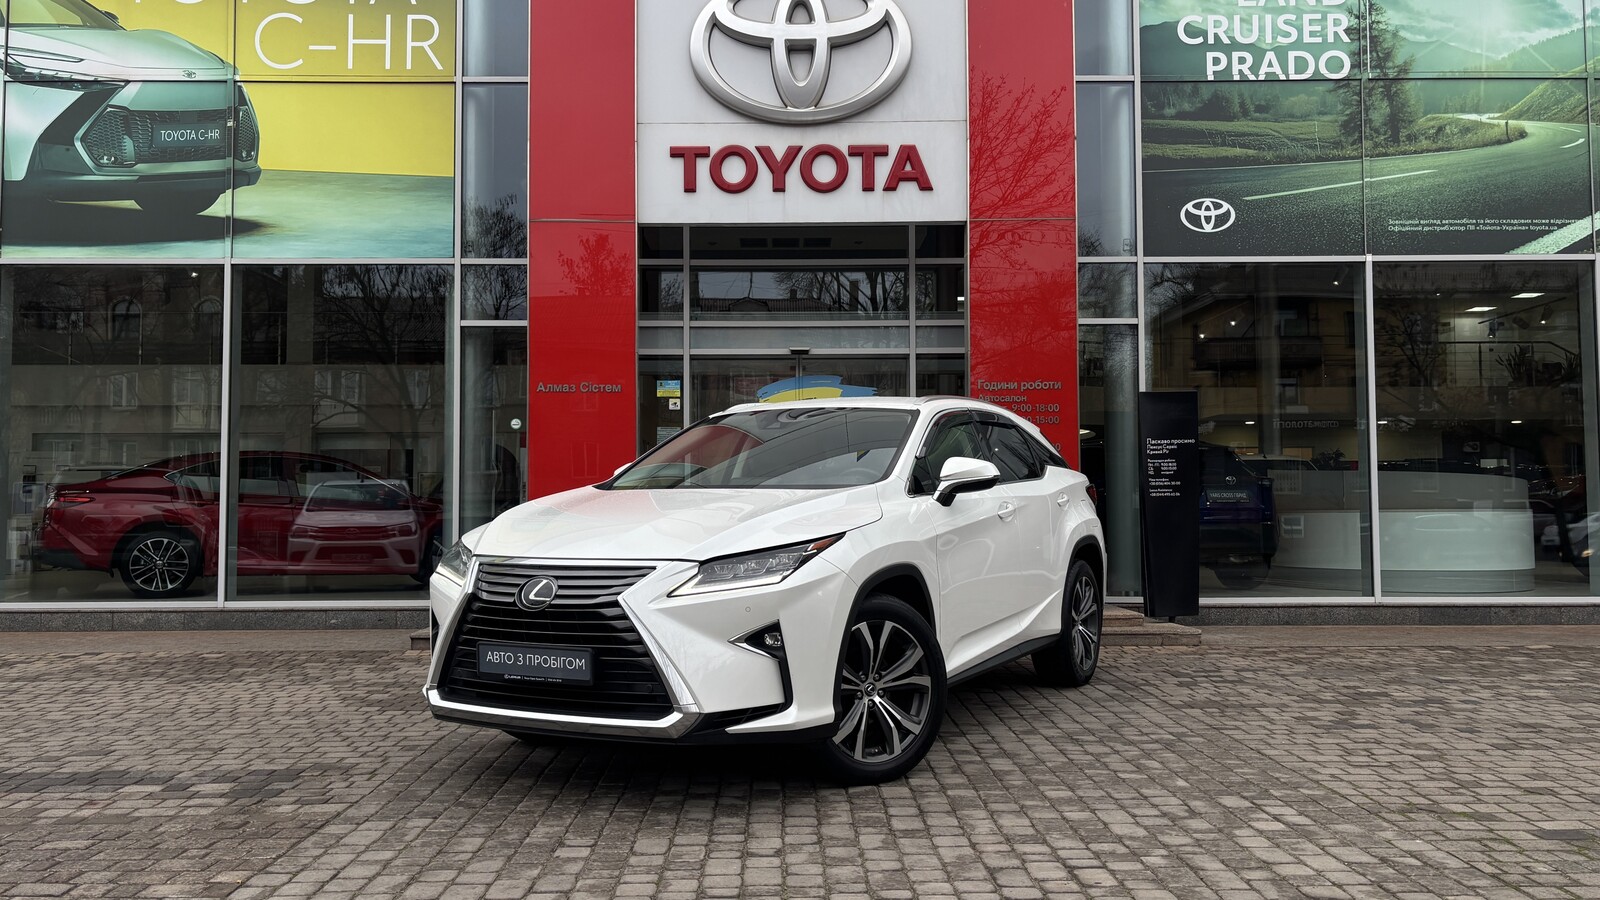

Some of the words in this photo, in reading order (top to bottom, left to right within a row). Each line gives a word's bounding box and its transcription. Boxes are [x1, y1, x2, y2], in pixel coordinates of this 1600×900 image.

[1176, 13, 1351, 45] CRUISER
[254, 12, 443, 70] C-HR
[1205, 50, 1351, 80] PRADO
[160, 129, 197, 142] TOYOTA
[198, 128, 220, 141] C-HR
[669, 144, 934, 194] TOYOTA
[1484, 217, 1499, 226] його
[1388, 225, 1422, 233] Офіційний
[536, 382, 577, 393] Алмаз
[580, 381, 622, 393] Сістем
[977, 379, 1018, 391] Години
[1020, 379, 1062, 391] роботи
[979, 394, 1027, 402] Автосалон
[486, 651, 515, 665] АВТО
[526, 654, 586, 670] ПРОБІГОМ
